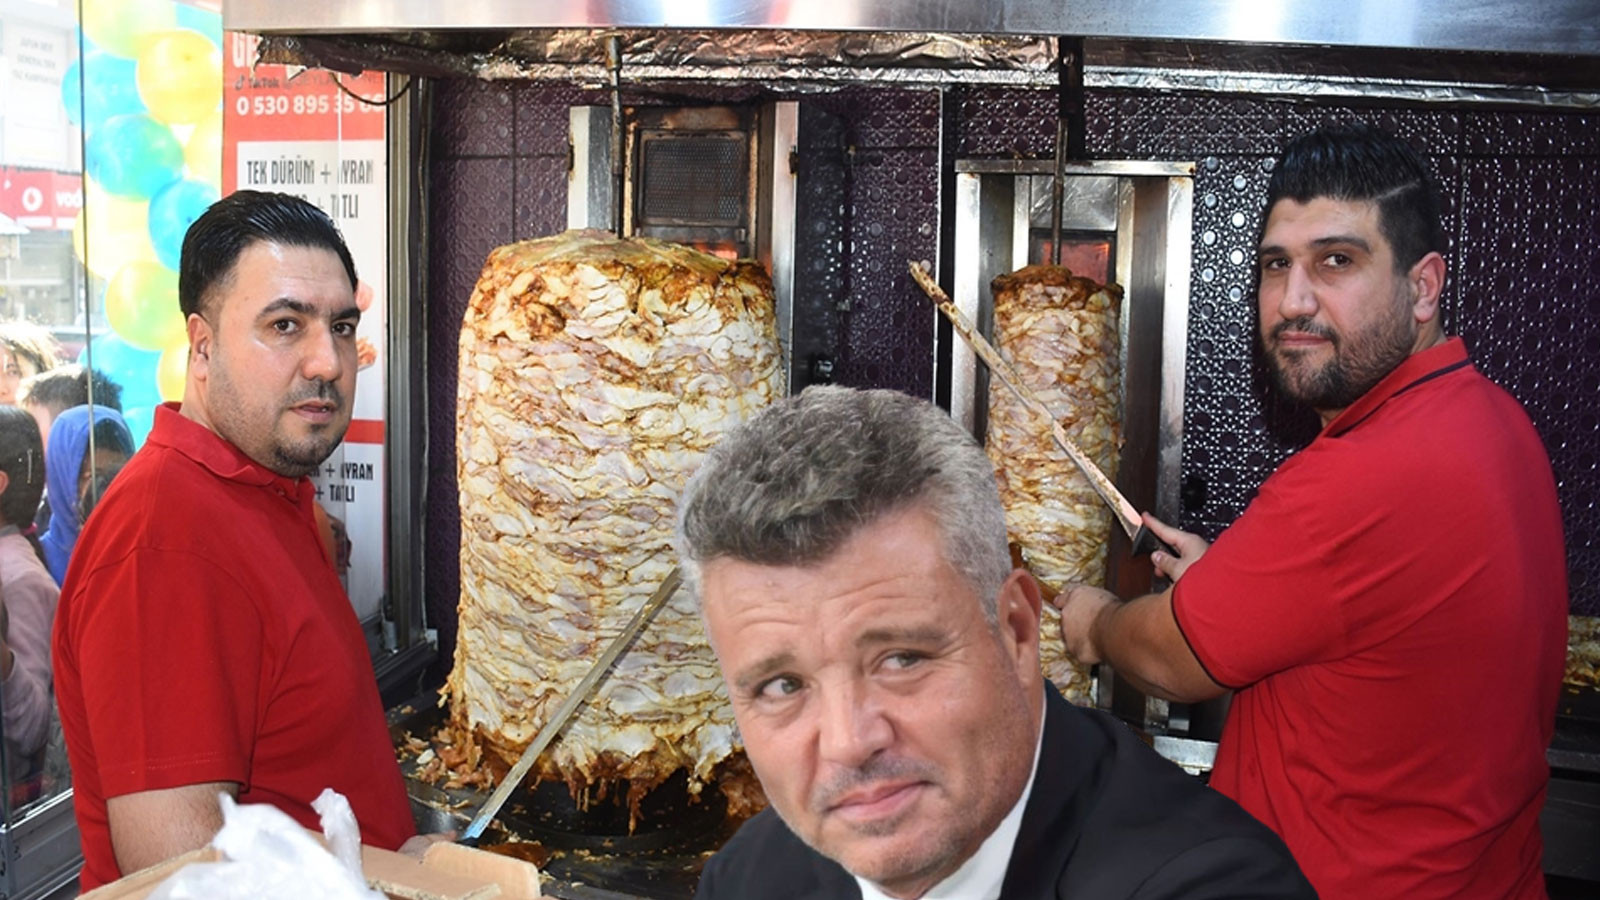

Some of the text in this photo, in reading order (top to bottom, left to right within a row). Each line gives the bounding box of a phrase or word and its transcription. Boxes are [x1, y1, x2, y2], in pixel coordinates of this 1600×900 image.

[236, 96, 249, 115] 0
[253, 95, 289, 115] 530
[293, 95, 329, 115] 895
[247, 160, 267, 184] TEK
[271, 155, 315, 184] DÜRÜM
